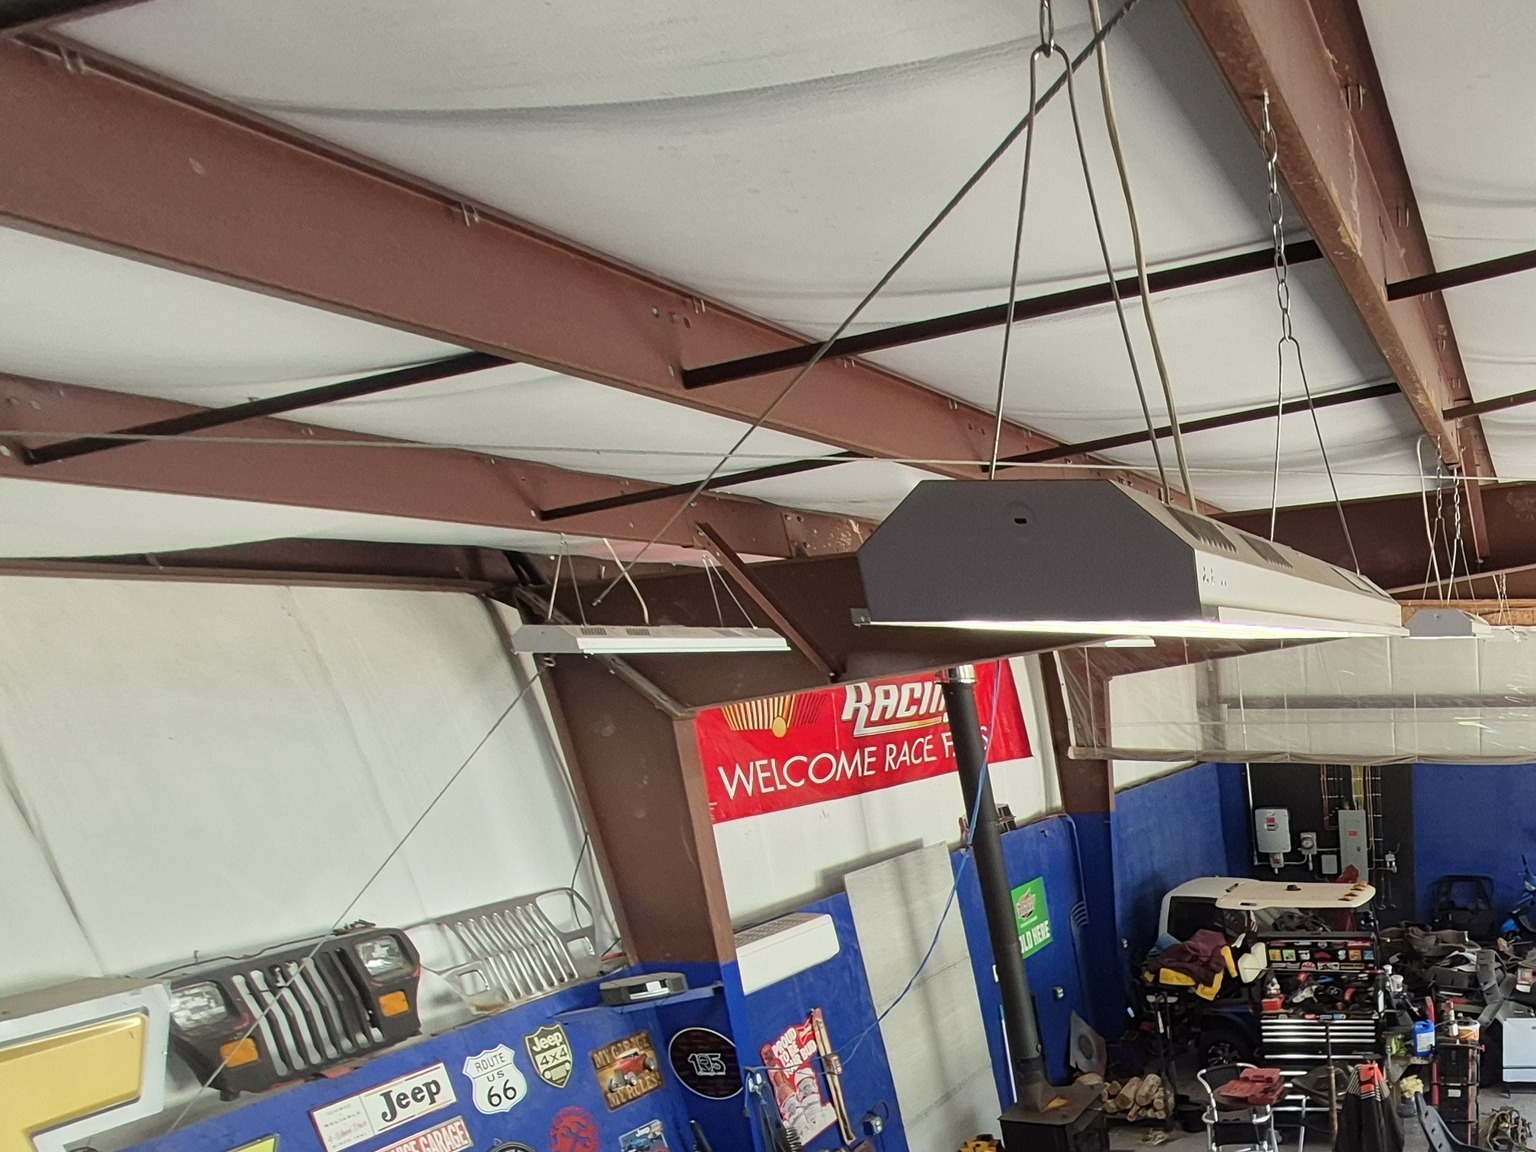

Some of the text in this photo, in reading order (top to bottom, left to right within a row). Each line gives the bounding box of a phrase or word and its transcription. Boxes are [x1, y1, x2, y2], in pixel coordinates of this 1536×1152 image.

[841, 681, 949, 737] RACIN
[718, 726, 988, 800] WELCOME RACE FS
[532, 1032, 563, 1052] Jeep
[611, 1032, 650, 1060] GARAGE
[474, 1051, 506, 1072] ROUTE
[486, 1071, 505, 1083] US
[380, 1078, 441, 1122] Jeep
[488, 1079, 517, 1107] 66
